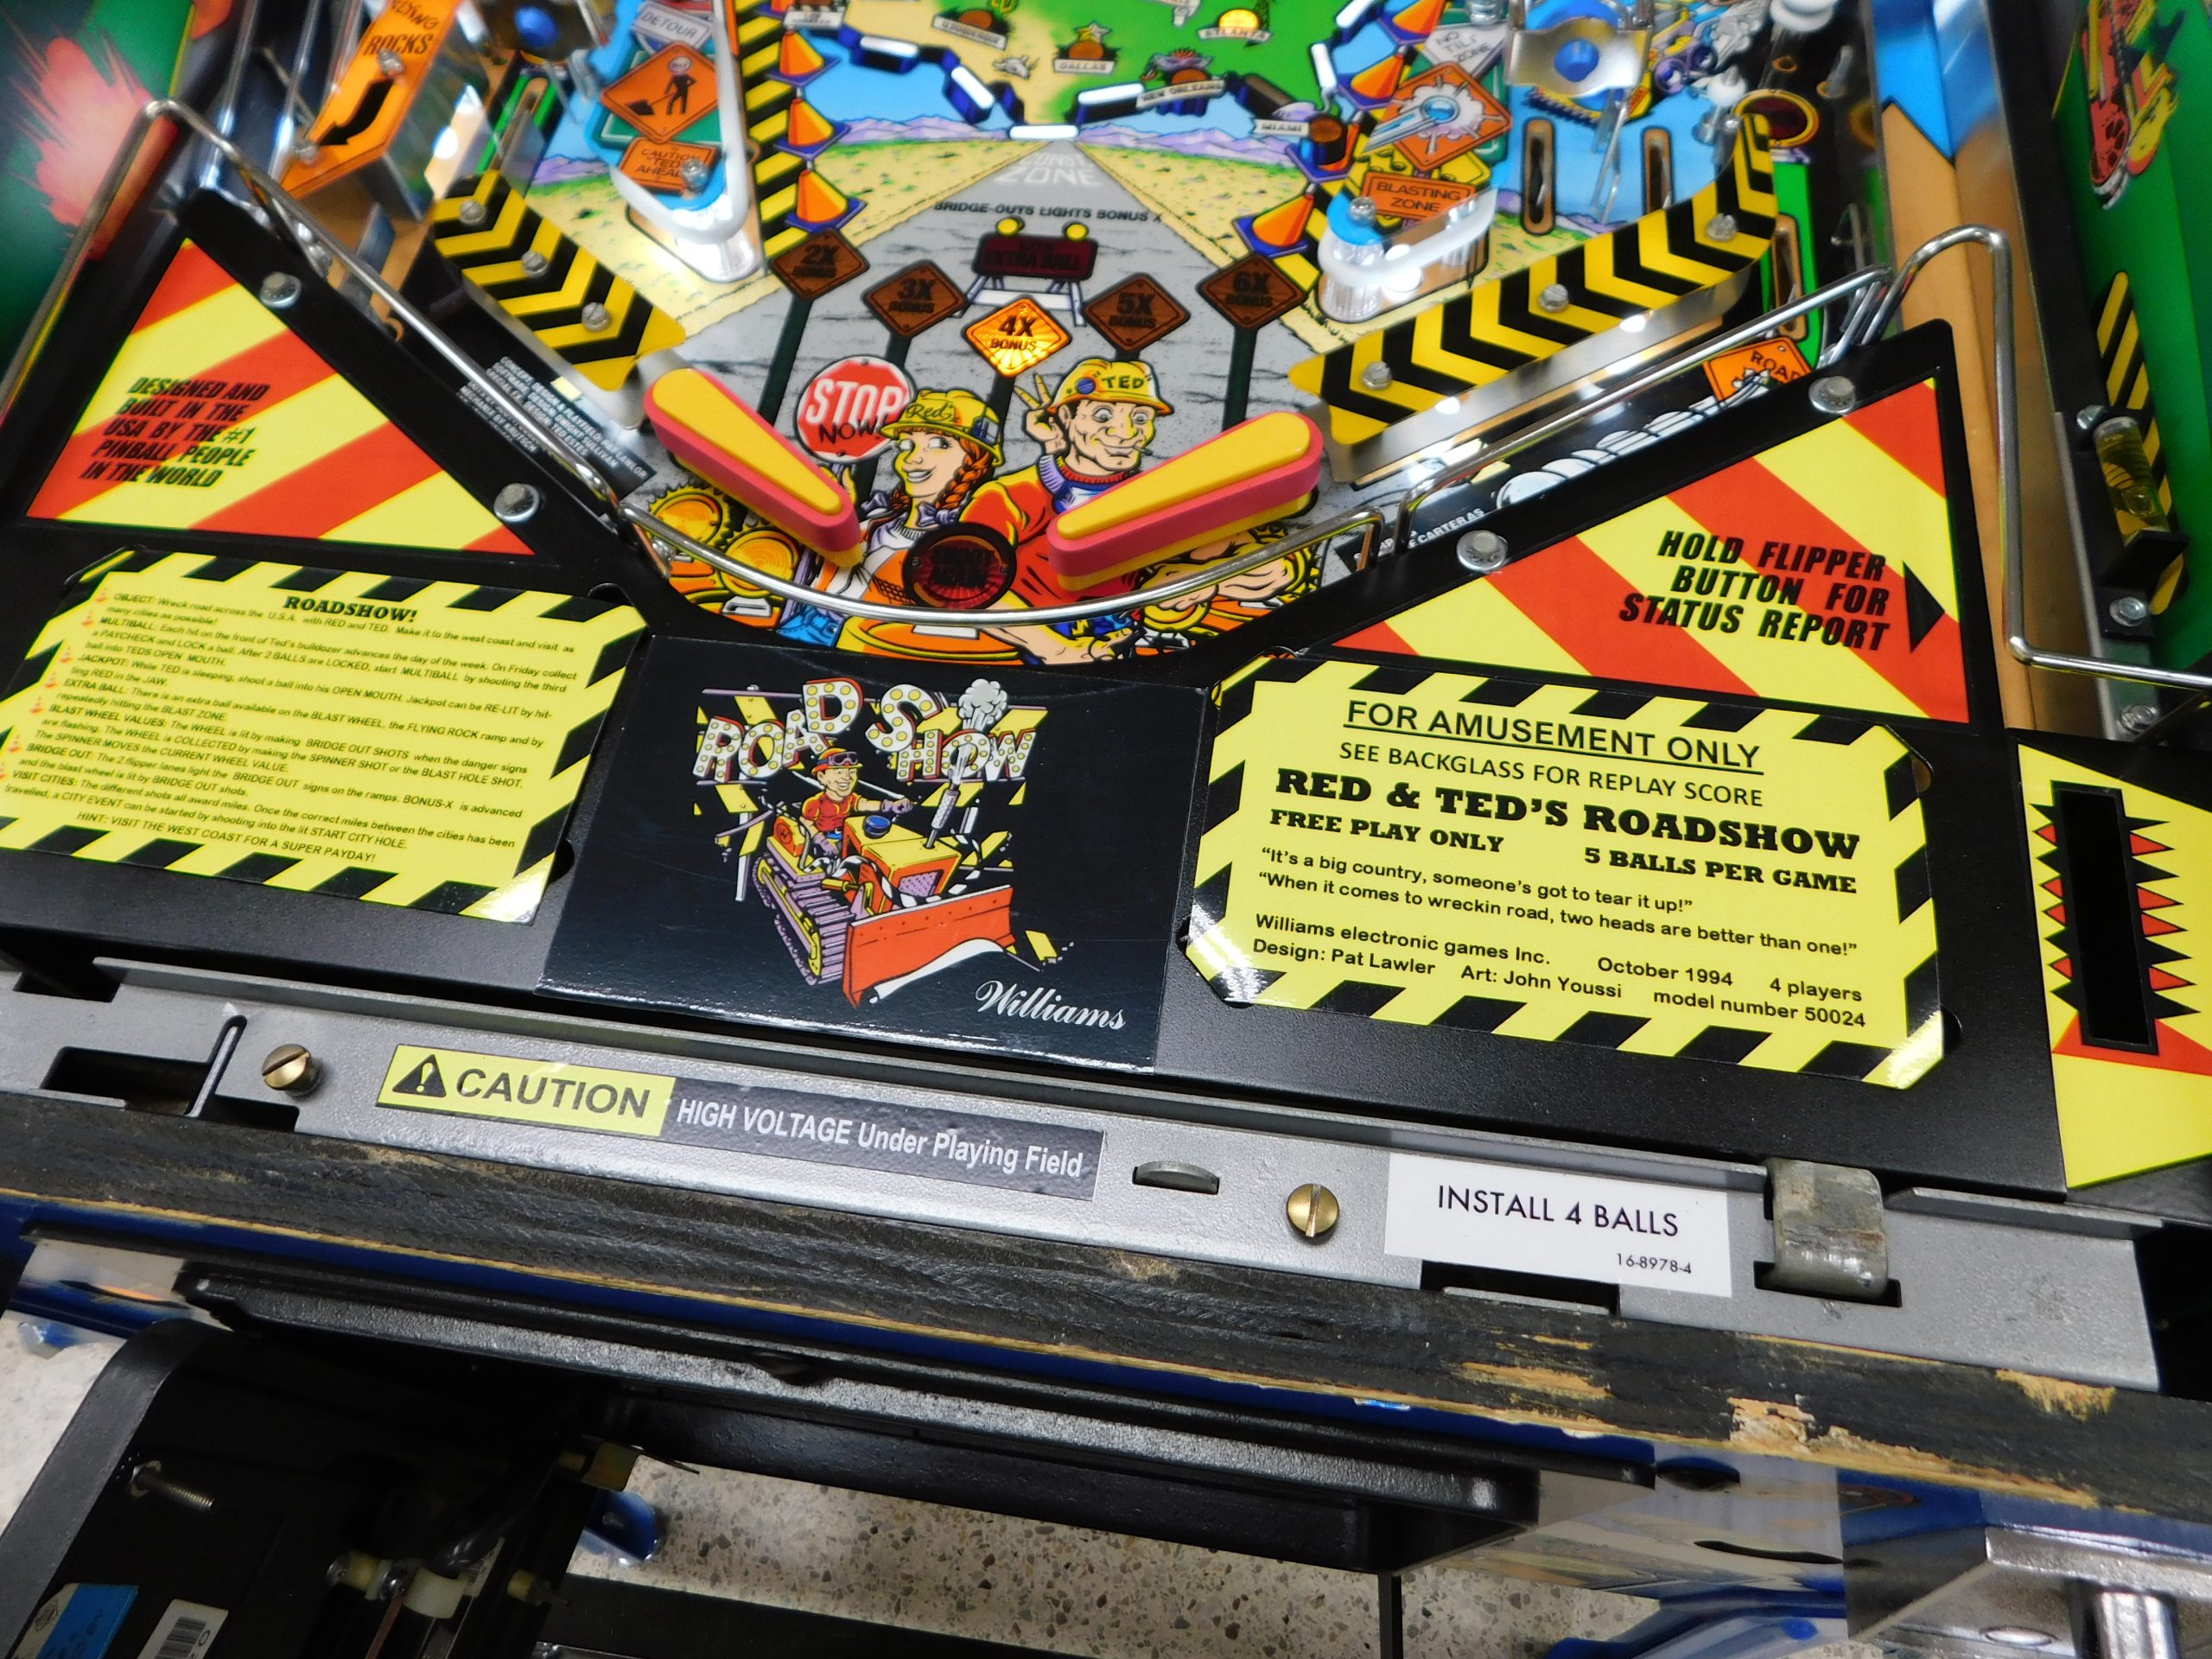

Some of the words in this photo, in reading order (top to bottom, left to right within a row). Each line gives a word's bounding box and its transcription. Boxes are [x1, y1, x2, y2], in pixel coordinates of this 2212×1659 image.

[641, 11, 697, 39] DETOUR
[1434, 30, 1459, 46] NO
[363, 33, 434, 56] ROCKS
[1446, 34, 1478, 53] TILT
[1454, 45, 1493, 62] ZONE
[641, 148, 701, 162] CAUTIO
[635, 164, 682, 178] AHEA
[995, 167, 1102, 185] ZONE
[1376, 181, 1462, 200] BLASTING
[933, 201, 1034, 216] BRIDGE-OUTS
[1039, 207, 1091, 219] LIGHTS
[1096, 209, 1147, 221] BONUS
[1390, 197, 1441, 213] ZONE
[800, 244, 840, 265] 2X
[897, 277, 937, 302] 3X
[1233, 270, 1269, 295] 6X
[1116, 292, 1156, 315] 5X
[997, 315, 1035, 338] 4X
[990, 338, 1037, 353] BONUS
[128, 378, 227, 398] DESIGNED
[222, 384, 270, 401] AND
[805, 378, 904, 425] STOP
[116, 397, 178, 417] BUILT
[176, 401, 205, 419] IN
[207, 403, 249, 422] THE
[103, 418, 149, 437] USA
[149, 421, 184, 439] BY
[185, 423, 227, 442] THE
[224, 428, 255, 444] #1
[93, 440, 176, 461] PINBALL
[178, 445, 255, 467] PEOPLE
[81, 461, 111, 480] IN
[108, 463, 150, 482] THE
[145, 466, 223, 487] WORLD
[1418, 514, 1469, 543] CARTER
[1657, 530, 1744, 564] HOLD
[1758, 541, 1886, 582] FLIPPER
[1670, 565, 1804, 606] BUTTON
[1825, 582, 1890, 616] FOR
[283, 595, 417, 622] ROADSHOW!
[1619, 593, 1744, 633] STATUS
[1758, 608, 1890, 651] REPORT
[693, 677, 862, 783] ROAD
[865, 683, 1037, 783] SHOW
[1347, 700, 1417, 730] FOR
[1427, 709, 1656, 756] AMUSEMENT
[1667, 736, 1759, 768] ONLY
[1339, 741, 1379, 762] SEE
[1389, 747, 1524, 779] BACKGLASS
[1533, 764, 1580, 786] FOR
[1589, 771, 1676, 797] REPLAY
[1684, 781, 1763, 807] SCORE
[1275, 767, 1371, 802] RED
[1386, 781, 1420, 809] &
[1583, 804, 1859, 860] ROADSHOW
[111, 817, 140, 827] VISIT
[143, 820, 165, 831] THE
[167, 824, 200, 836] WEST
[201, 829, 242, 842] COAST
[243, 835, 269, 846] FOR
[269, 839, 278, 848] A
[281, 841, 322, 855] SUPER
[1269, 808, 1342, 833] FREE
[1350, 818, 1421, 842] PLAY
[1429, 829, 1504, 853] ONLY
[1303, 856, 1313, 867] a
[1319, 855, 1347, 874] big
[1352, 862, 1427, 884] country,
[1537, 885, 1567, 899] got
[1572, 887, 1590, 901] to
[1594, 889, 1632, 906] tear
[1637, 894, 1649, 908] it
[1585, 847, 1600, 864] 5
[1609, 849, 1696, 875] BALLS
[1705, 861, 1764, 883] PER
[1772, 868, 1857, 893] GAME
[1323, 880, 1334, 894] it
[1338, 885, 1399, 902] comes
[1404, 890, 1422, 905] to
[1427, 896, 1501, 915] wreckin
[1507, 906, 1554, 924] road,
[1560, 909, 1593, 925] two
[1599, 913, 1655, 933] heads
[1661, 925, 1691, 938] are
[1697, 925, 1755, 944] better
[1759, 932, 1801, 950] than
[1255, 913, 1335, 938] Williams
[1340, 925, 1438, 950] electronic
[1444, 941, 1509, 959] games
[1516, 946, 1549, 964] Inc.
[1253, 938, 1325, 962] Design:
[1331, 948, 1363, 966] Pat
[1369, 952, 1436, 975] Lawler
[1460, 964, 1497, 982] Art:
[1503, 970, 1551, 989] John
[1557, 976, 1621, 998] Youssi
[1598, 957, 1679, 979] October
[1685, 967, 1732, 986] 1994
[1769, 977, 1782, 992] 4
[1787, 980, 1862, 1001] players
[976, 980, 1127, 1031] Williams
[1653, 991, 1714, 1009] model
[1720, 1000, 1798, 1019] number
[1804, 1006, 1866, 1027] 50024
[455, 1068, 651, 1118] CAUTION
[677, 1098, 737, 1129] HIGH
[744, 1106, 853, 1145] VOLTAGE
[857, 1122, 928, 1154] Under
[932, 1131, 1019, 1173] Playing
[1025, 1145, 1084, 1181] Field
[1439, 1185, 1554, 1222] INSTALL
[1565, 1202, 1582, 1224] 4
[1594, 1204, 1678, 1236] BALLS
[1618, 1253, 1692, 1274] 16-8978-4
